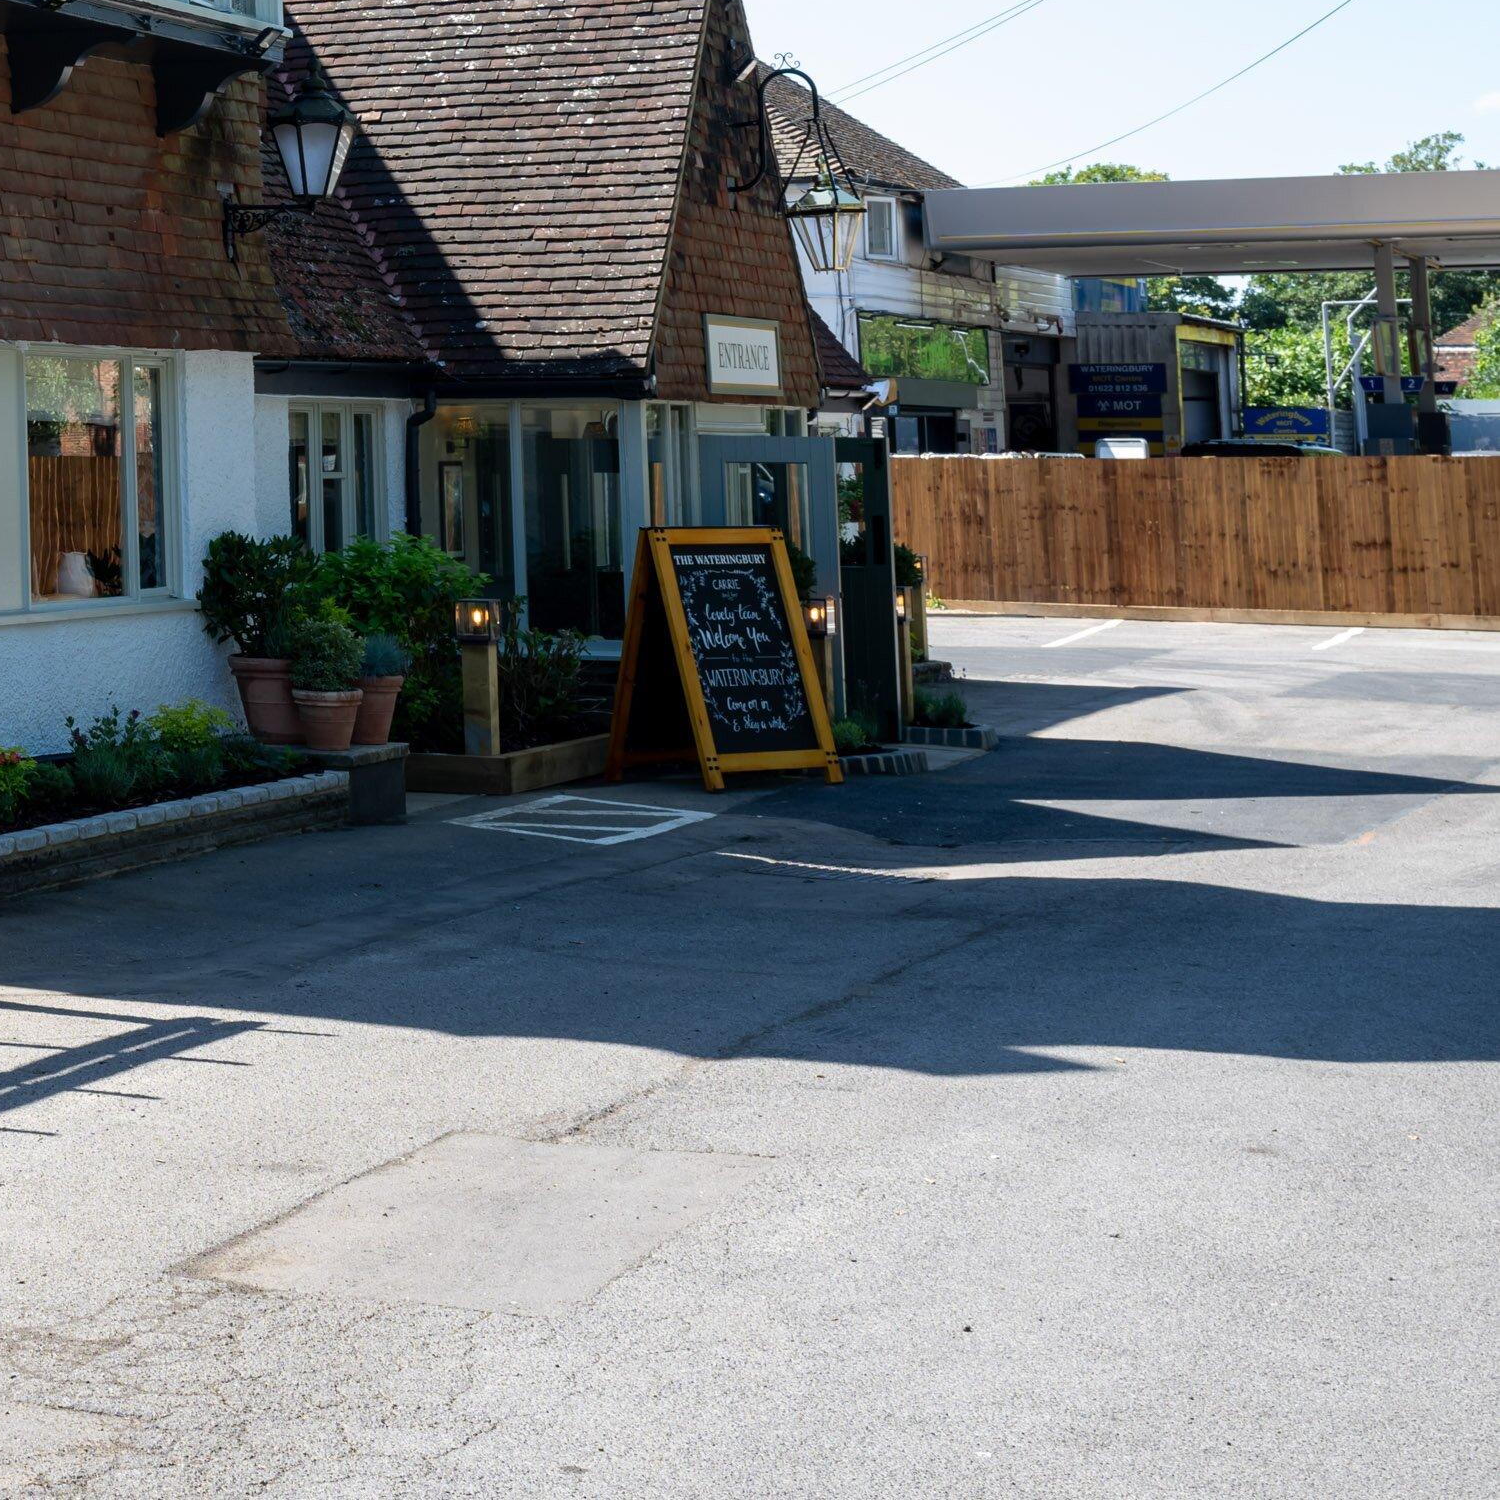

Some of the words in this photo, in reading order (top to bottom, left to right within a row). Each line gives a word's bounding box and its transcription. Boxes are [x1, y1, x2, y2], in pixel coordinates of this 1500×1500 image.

[717, 340, 770, 371] ENTRANCE
[1080, 364, 1155, 373] WATERINGBURY
[1092, 375, 1112, 383] MOT
[1115, 375, 1143, 383] Centre
[1368, 378, 1375, 388] 1
[1407, 378, 1416, 388] 2
[1113, 400, 1142, 411] MOT
[1255, 409, 1313, 427] Wateringbury
[673, 554, 694, 566] THE
[694, 553, 766, 565] WATERINGBURY
[712, 578, 742, 591] CARRIE
[734, 603, 762, 621] team
[697, 621, 747, 650] Welcome
[746, 626, 772, 653] You
[731, 652, 740, 662] to
[742, 652, 754, 662] the
[705, 668, 786, 687] WATERINGBURY
[726, 696, 749, 713] Come
[748, 699, 759, 711] on
[760, 698, 772, 712] in
[743, 714, 761, 733] Stay
